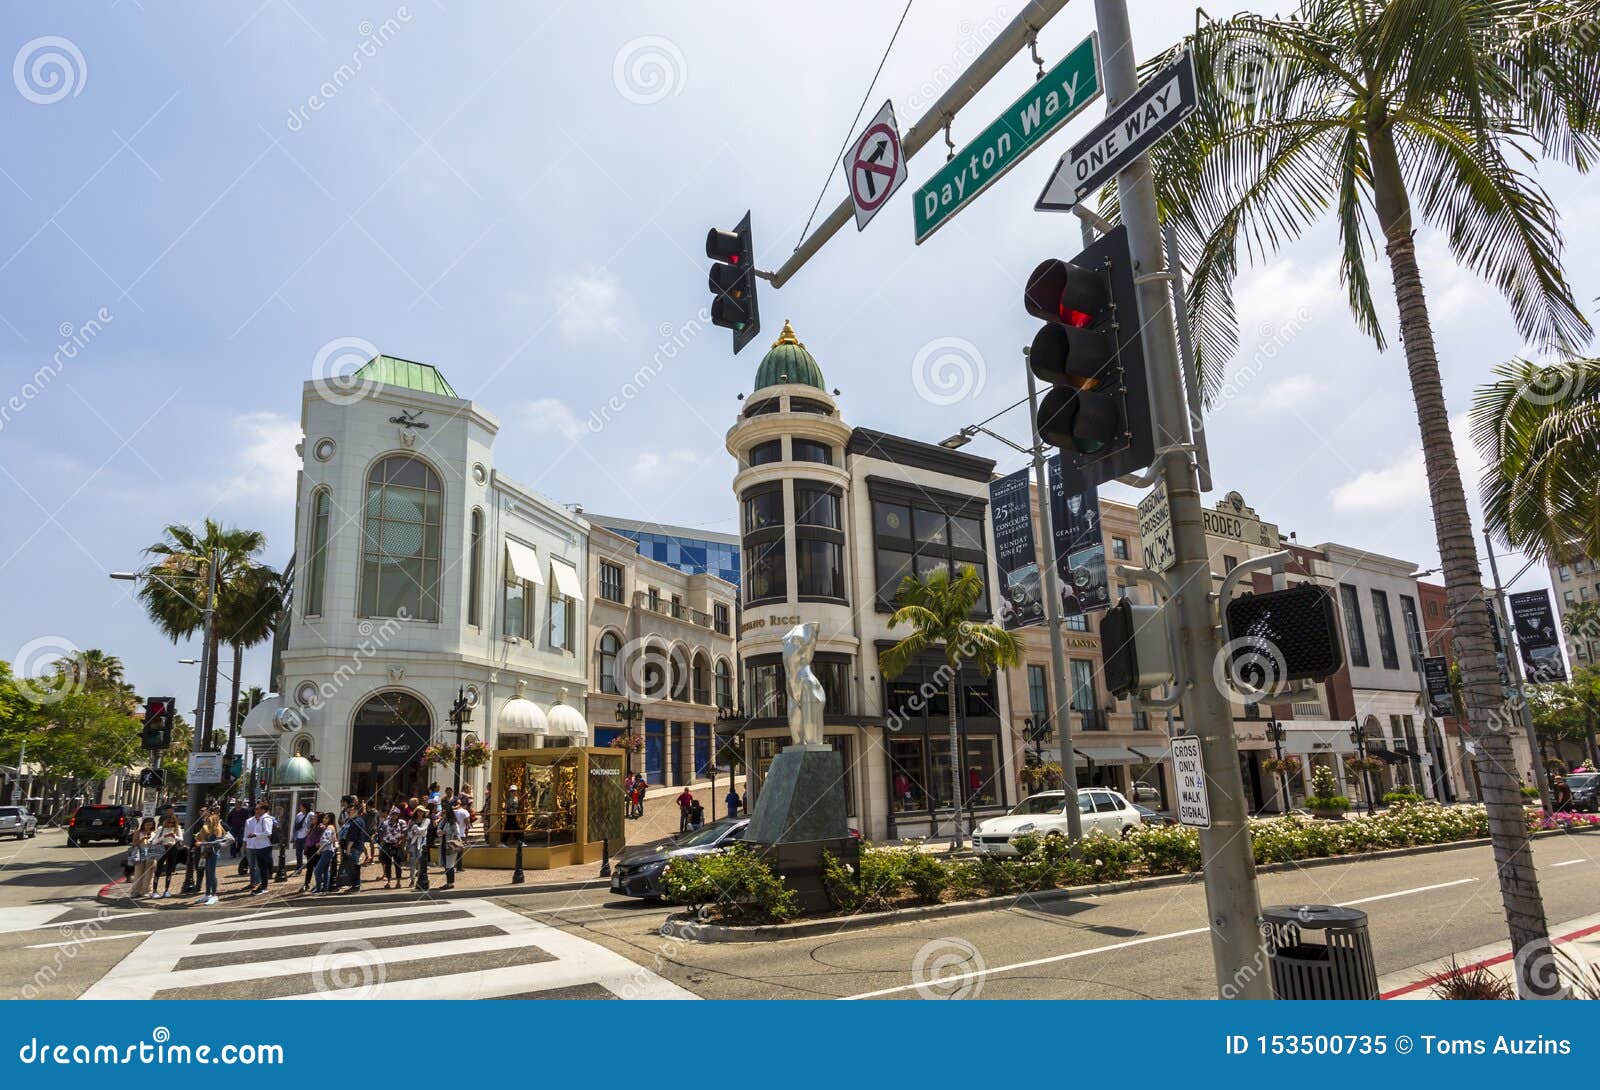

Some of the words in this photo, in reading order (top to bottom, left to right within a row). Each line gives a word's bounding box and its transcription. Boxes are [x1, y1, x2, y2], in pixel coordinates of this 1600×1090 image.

[1076, 138, 1118, 181] ONE
[1124, 85, 1173, 141] WAY
[923, 132, 1011, 220] Dayton
[1020, 70, 1079, 137] Way
[1139, 488, 1167, 521] DIAGONAL
[996, 514, 1029, 532] CONCOURS
[1140, 504, 1169, 538] CROSSING
[1203, 512, 1242, 538] RODEO
[999, 535, 1028, 551] SUNDAY
[1144, 543, 1158, 570] OK
[1174, 745, 1197, 758] CROSS
[1178, 760, 1196, 773] ONLY
[1184, 776, 1195, 788] ON
[1182, 791, 1201, 803] WALK
[1181, 806, 1206, 819] SIGNAL
